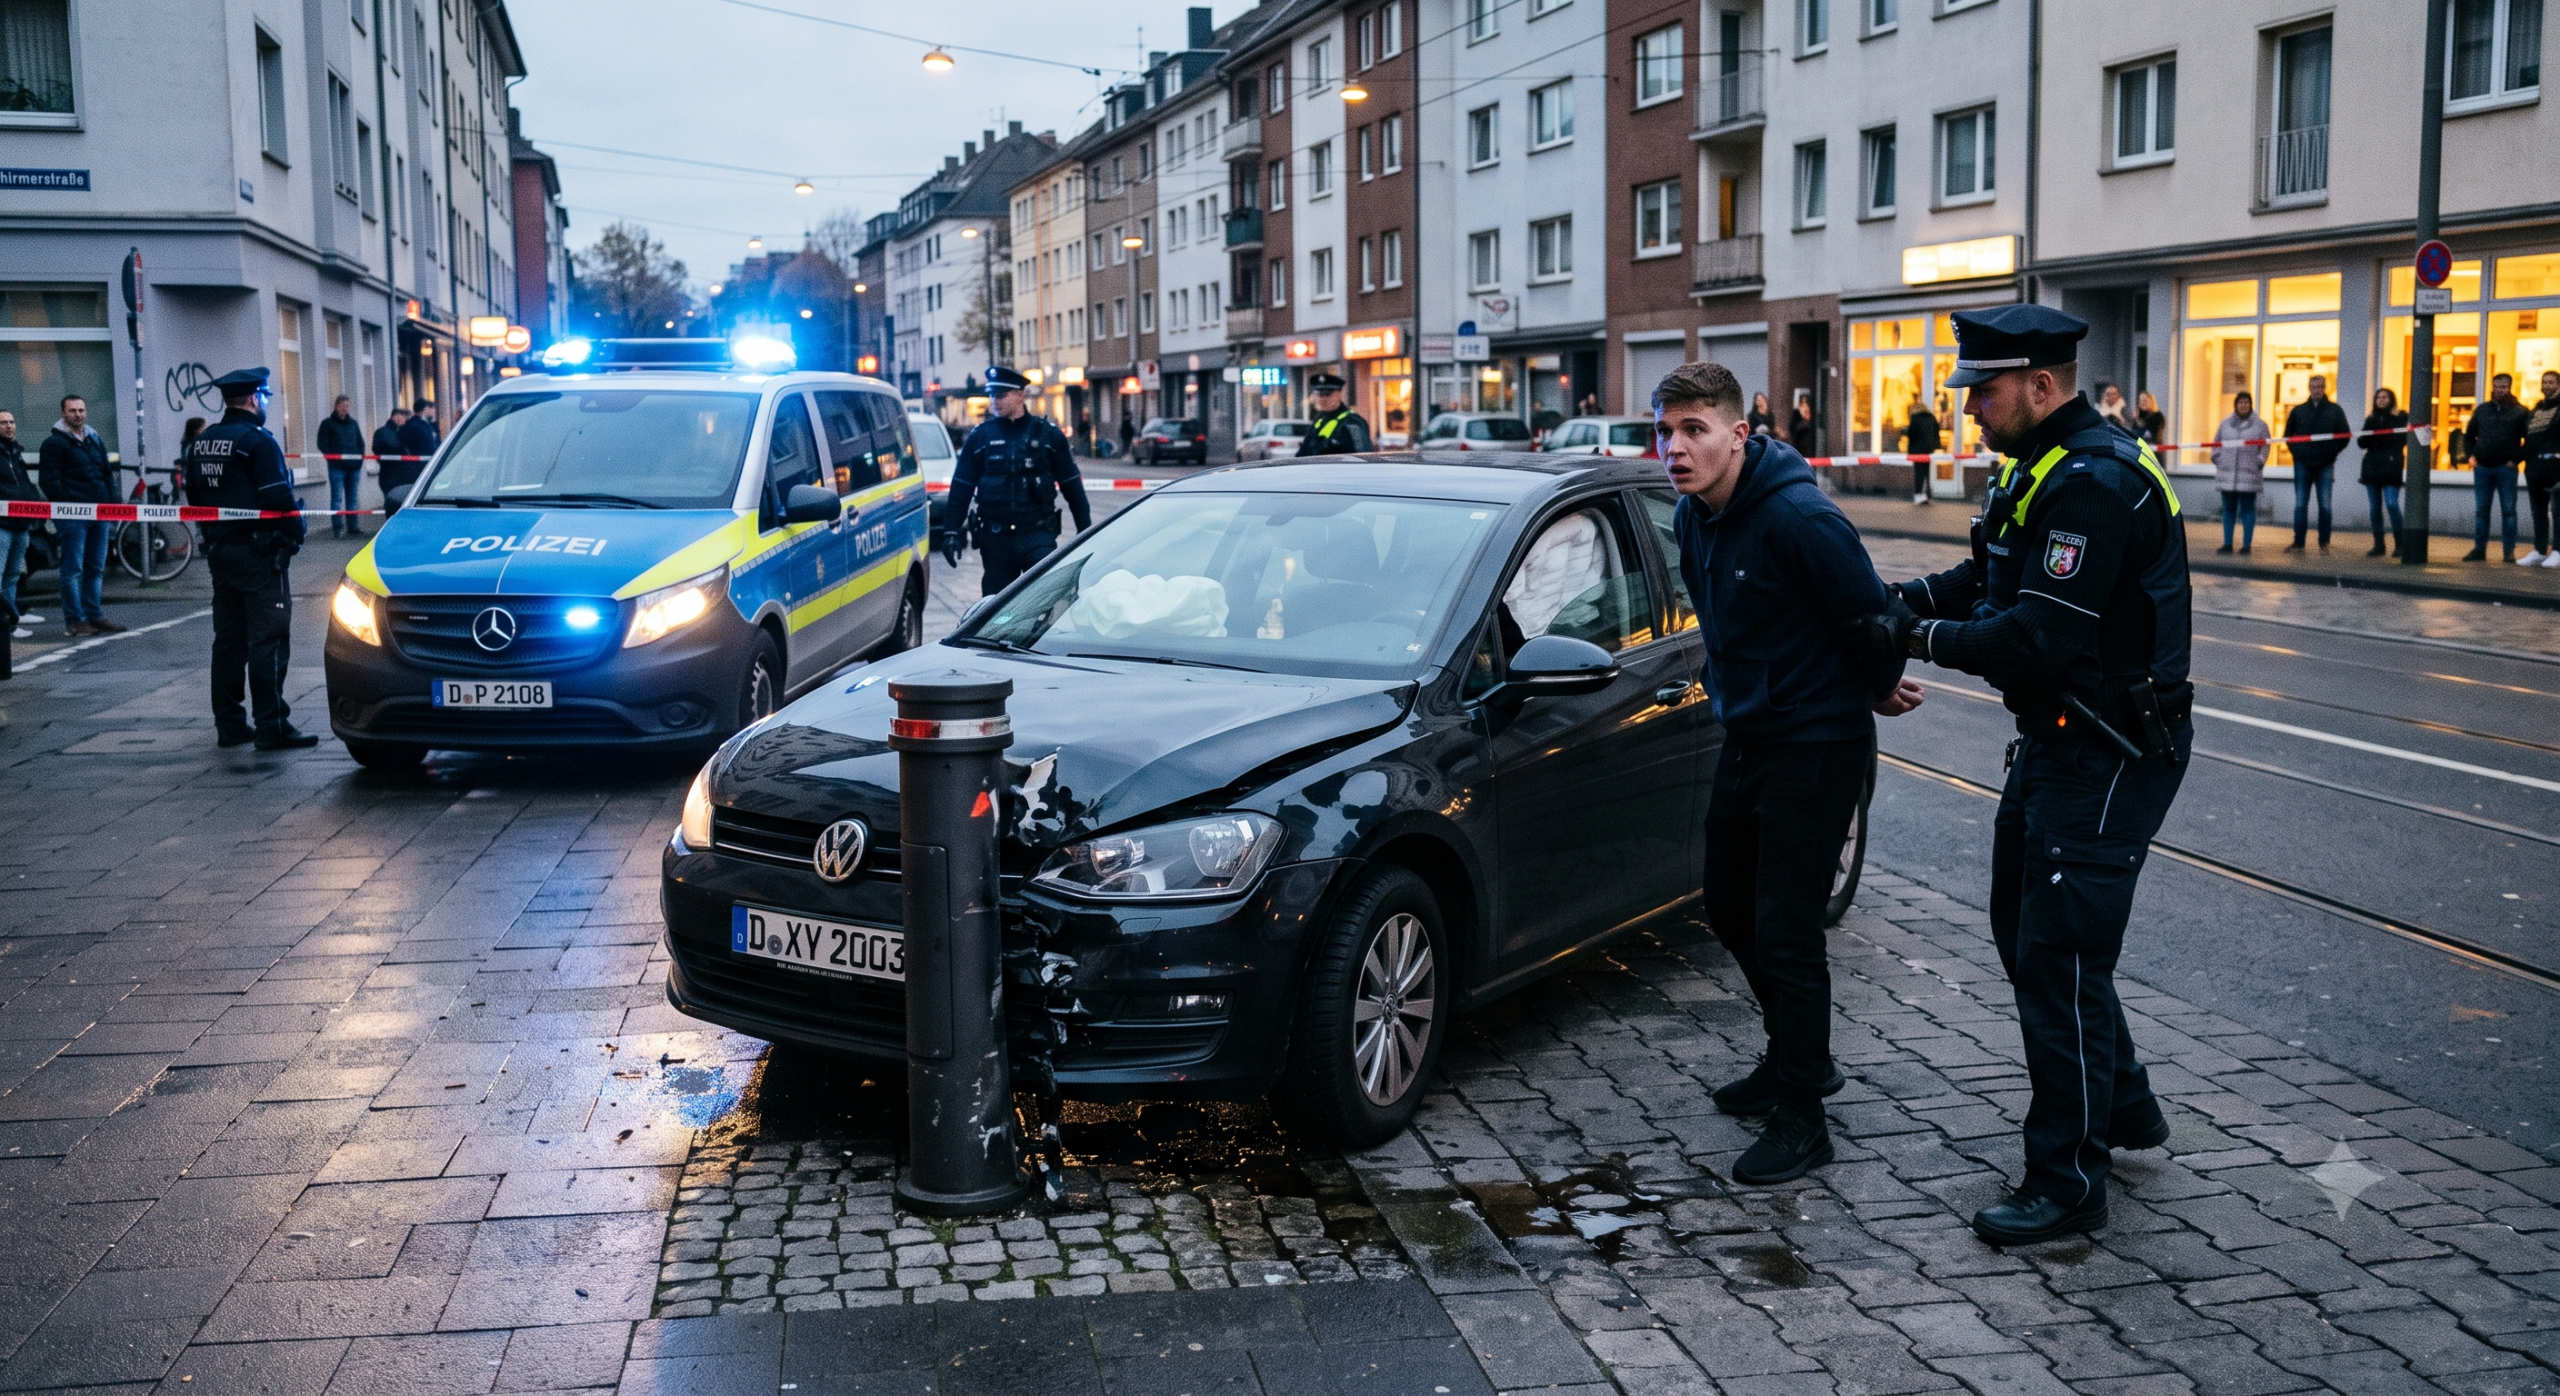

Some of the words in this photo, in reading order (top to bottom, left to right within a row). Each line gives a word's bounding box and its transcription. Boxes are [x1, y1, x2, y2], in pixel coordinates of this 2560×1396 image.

[0, 171, 84, 186] hirmerstraße
[193, 440, 233, 456] POLIZEI
[201, 463, 223, 475] NRW
[440, 535, 608, 556] POLIZEI
[855, 522, 887, 559] POLIZEI
[448, 684, 461, 703] D
[474, 684, 487, 704] P
[494, 685, 545, 704] 2108
[749, 914, 765, 950] D
[785, 921, 822, 960] XY
[830, 929, 905, 974] 2003
